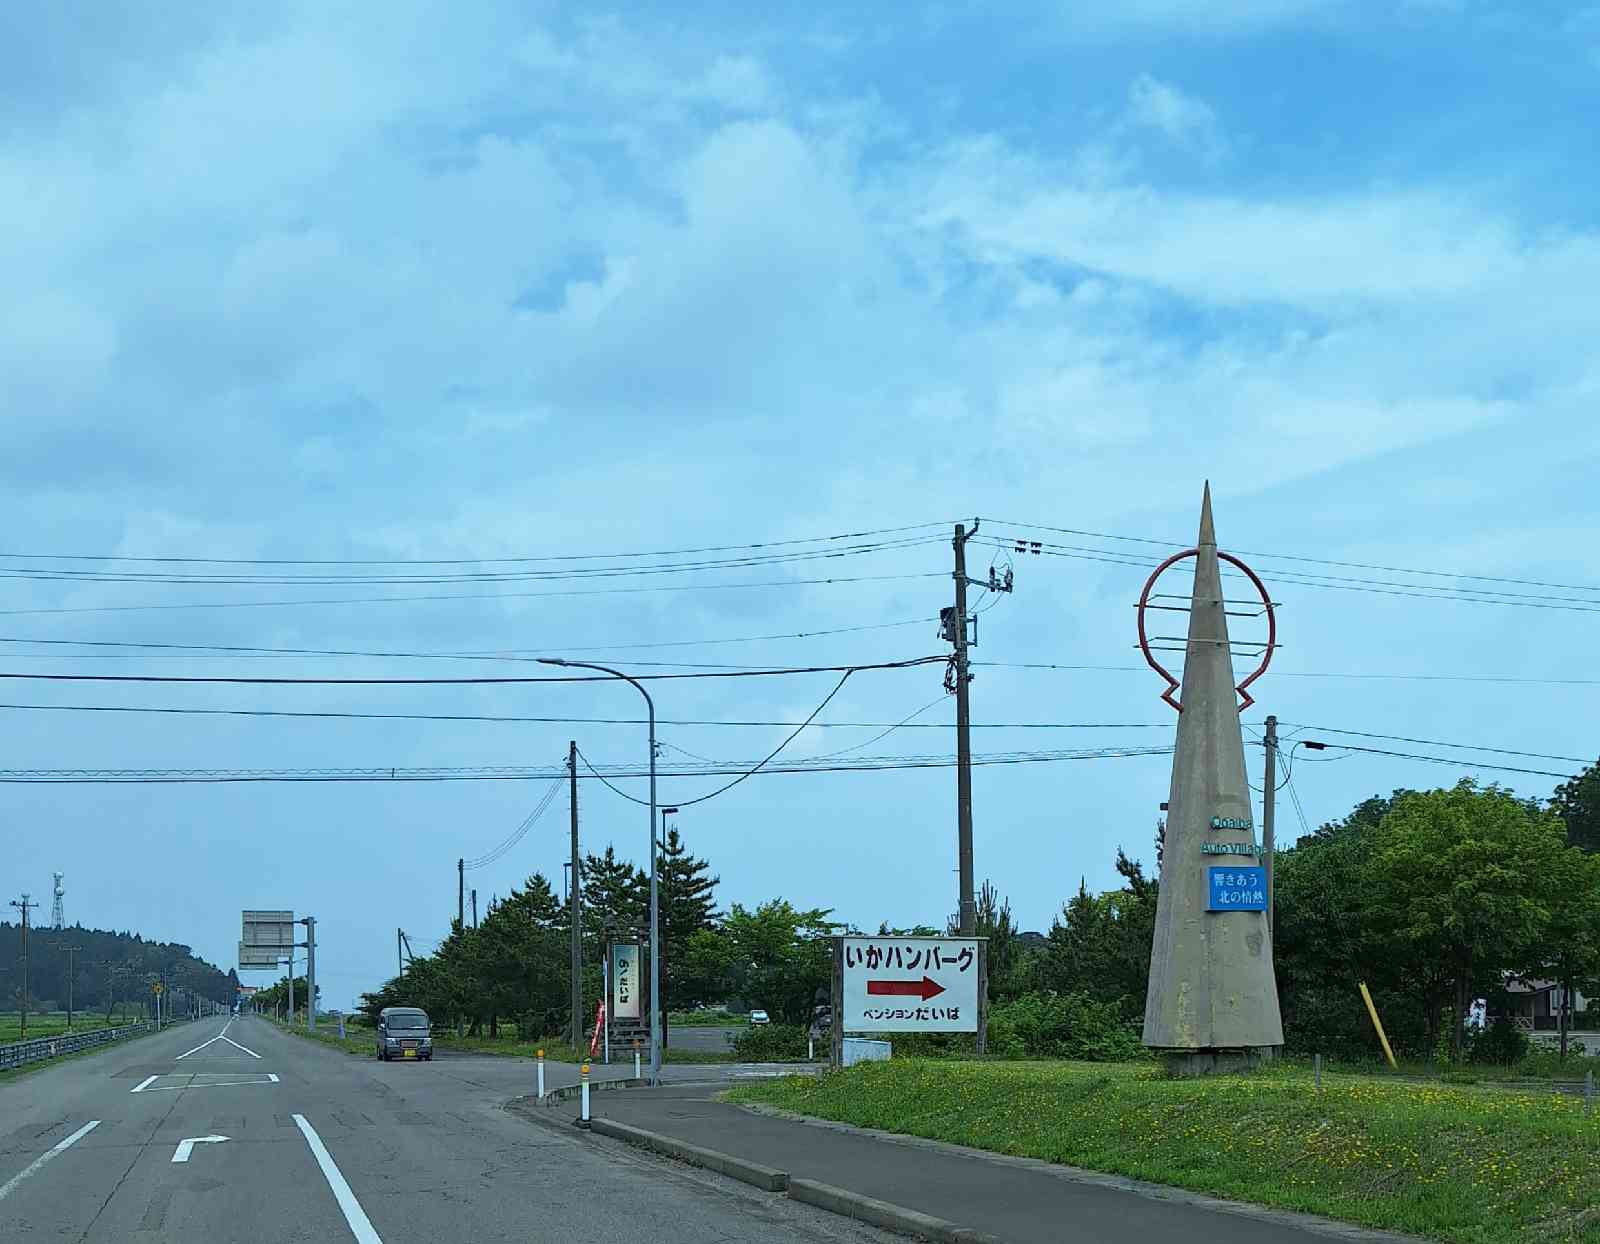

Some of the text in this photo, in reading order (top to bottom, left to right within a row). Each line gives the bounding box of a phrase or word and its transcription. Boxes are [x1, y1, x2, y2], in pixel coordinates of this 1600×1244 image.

[1215, 873, 1257, 887] 響きあう
[1218, 890, 1264, 904] 北の情熱
[846, 944, 975, 972] いかハンバーグ
[863, 1006, 960, 1021] ペンションだいば
